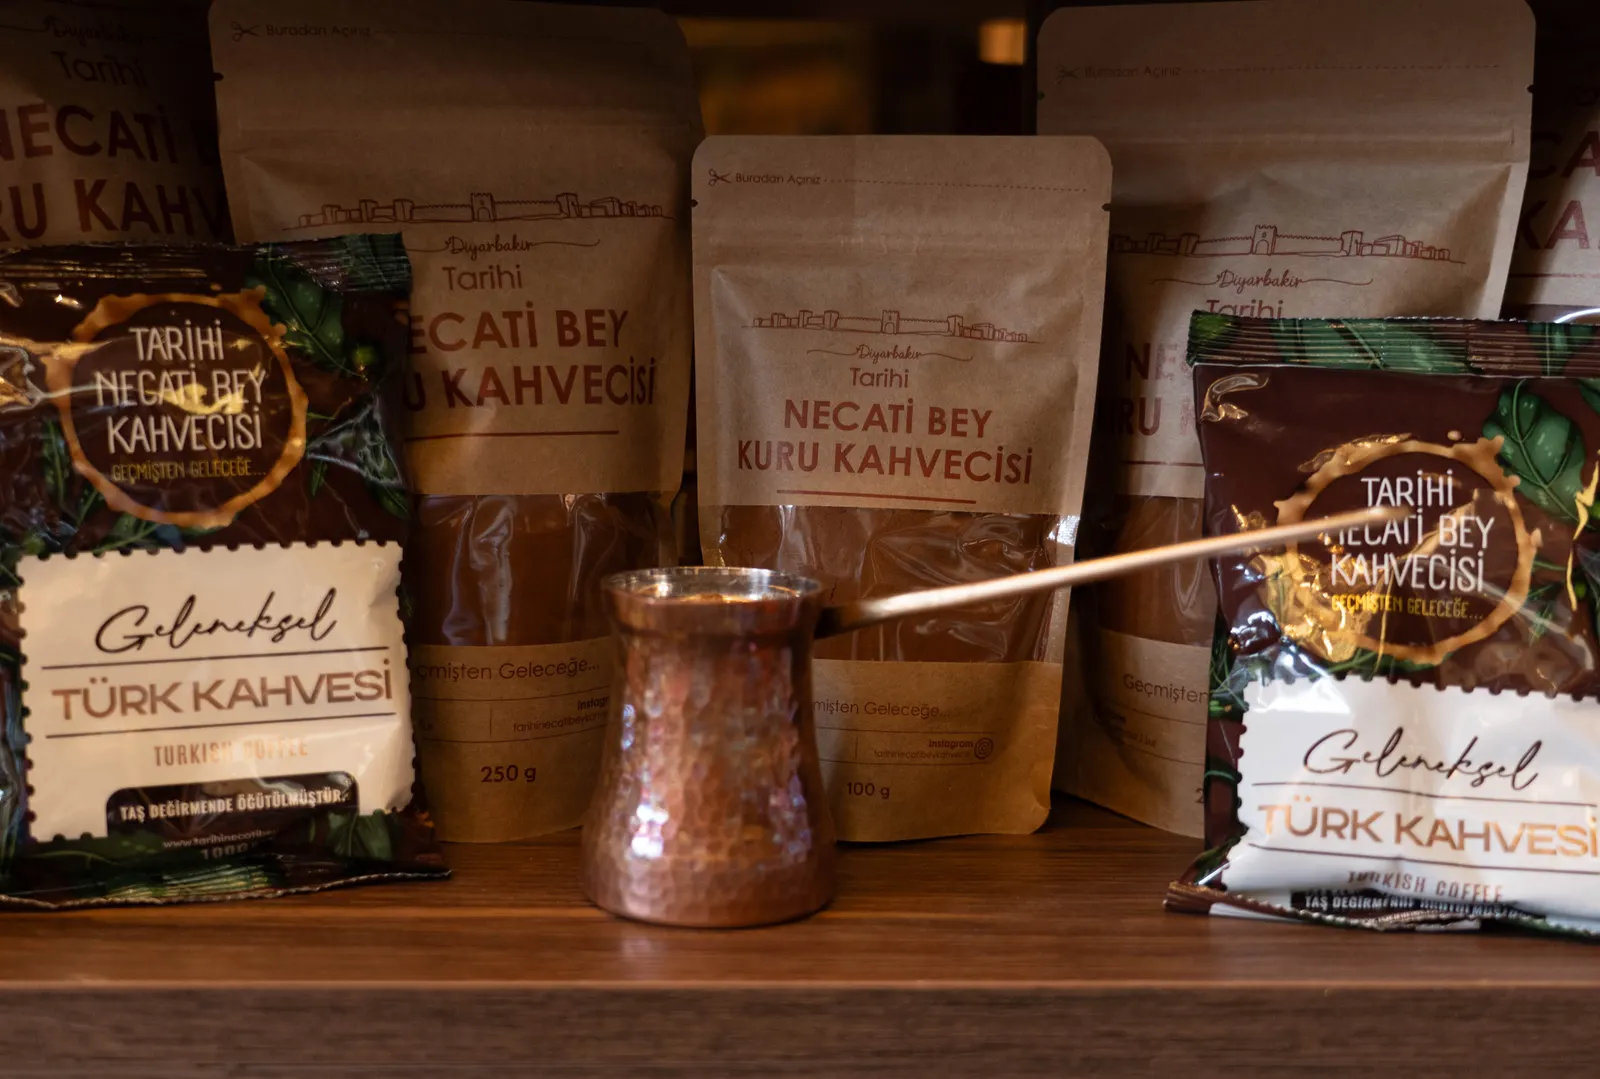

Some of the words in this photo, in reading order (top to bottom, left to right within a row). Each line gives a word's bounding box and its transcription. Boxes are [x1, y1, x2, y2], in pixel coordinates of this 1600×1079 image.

[266, 23, 327, 37] Buradan
[51, 51, 147, 86] Tarihi
[735, 172, 784, 184] Buradan
[787, 174, 821, 186] Açınız
[445, 234, 535, 260] Diyarbakır
[442, 264, 523, 291] Tarihi
[1216, 269, 1302, 295] Diyarbakır
[129, 318, 224, 361] TARİHİ
[555, 309, 629, 348] BEY
[856, 344, 922, 362] Diyarbakır
[94, 362, 201, 407] NECATİ
[212, 368, 266, 406] BEY
[441, 356, 656, 409] KAHVECİSİ
[850, 366, 909, 389] Tarihi
[784, 398, 914, 434] NECATİ
[928, 406, 993, 439] BEY
[111, 459, 186, 485] GEÇMİŞTEN
[738, 439, 820, 473] KURU
[834, 445, 1033, 485] KAHVECİSİ
[1360, 469, 1453, 508] TARİHİ
[1438, 514, 1495, 549] BEY
[1330, 549, 1485, 593] KAHVECİSİ
[1331, 591, 1403, 615] GEÇMİŞTEN
[95, 587, 338, 653] Geleneksel
[499, 657, 600, 681] Geleceğe...
[51, 677, 183, 721] TÜRK
[193, 658, 394, 713] KAHVESİ
[1123, 673, 1208, 703] Geçmişten
[864, 702, 950, 720] Geleceğe...
[153, 740, 233, 767] TURKISH
[928, 739, 974, 751] Instagram
[1303, 727, 1543, 791] Geleneksel
[480, 765, 519, 783] 250
[524, 767, 537, 782] g
[847, 781, 876, 797] 100
[880, 785, 890, 799] g
[119, 805, 146, 823] TAŞ
[150, 797, 234, 819] DEĞİRMENDE
[1258, 795, 1384, 844] TÜRK
[1394, 806, 1600, 859] KAHVESİ
[1305, 895, 1329, 911] TAŞ
